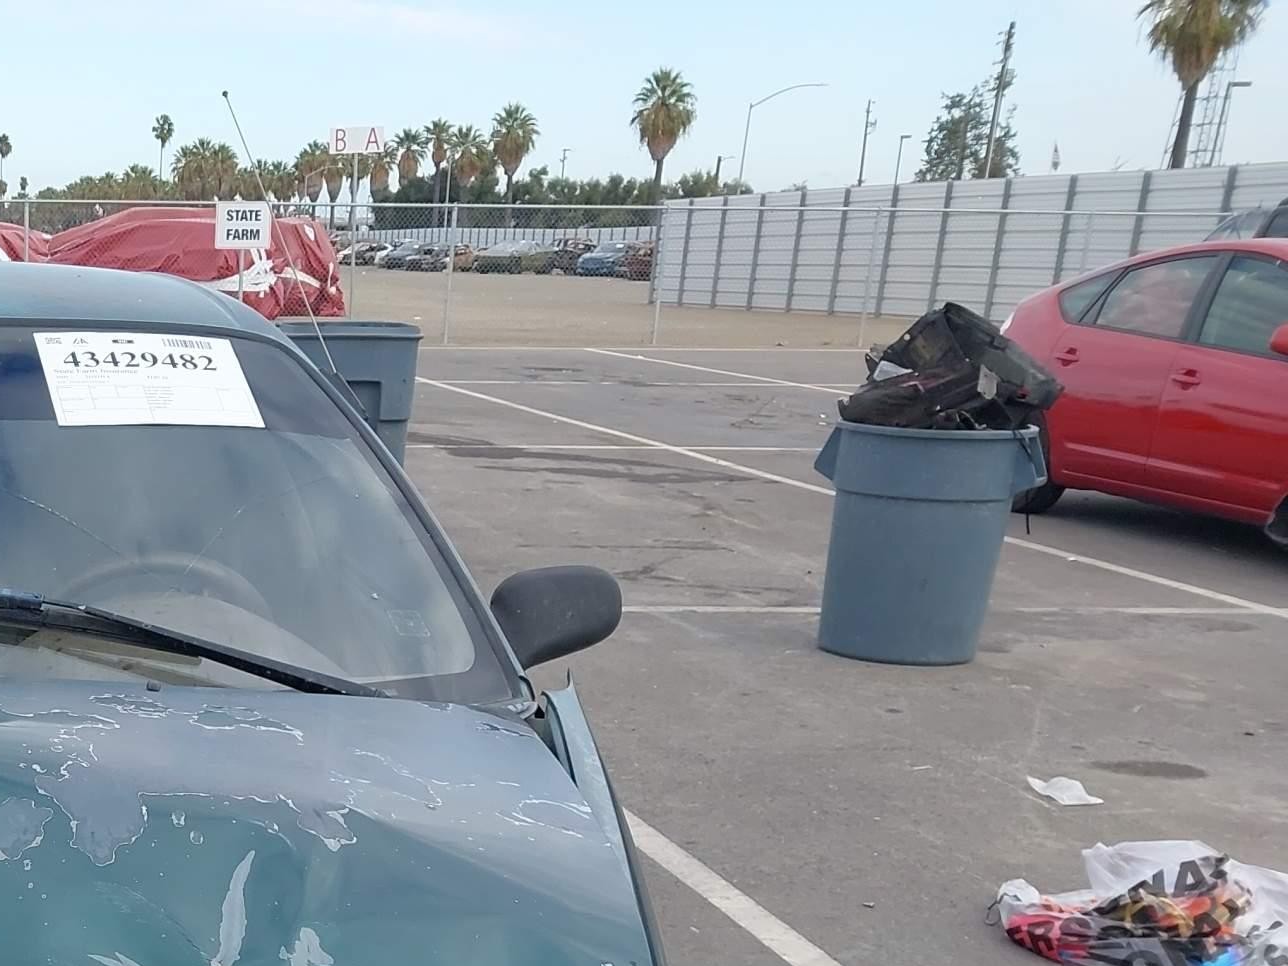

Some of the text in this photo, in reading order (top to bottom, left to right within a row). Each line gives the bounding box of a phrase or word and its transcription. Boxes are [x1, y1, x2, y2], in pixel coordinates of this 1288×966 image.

[335, 127, 380, 152] B A
[226, 209, 262, 221] STATE
[226, 228, 261, 241] FARM
[63, 350, 217, 372] 43429482
